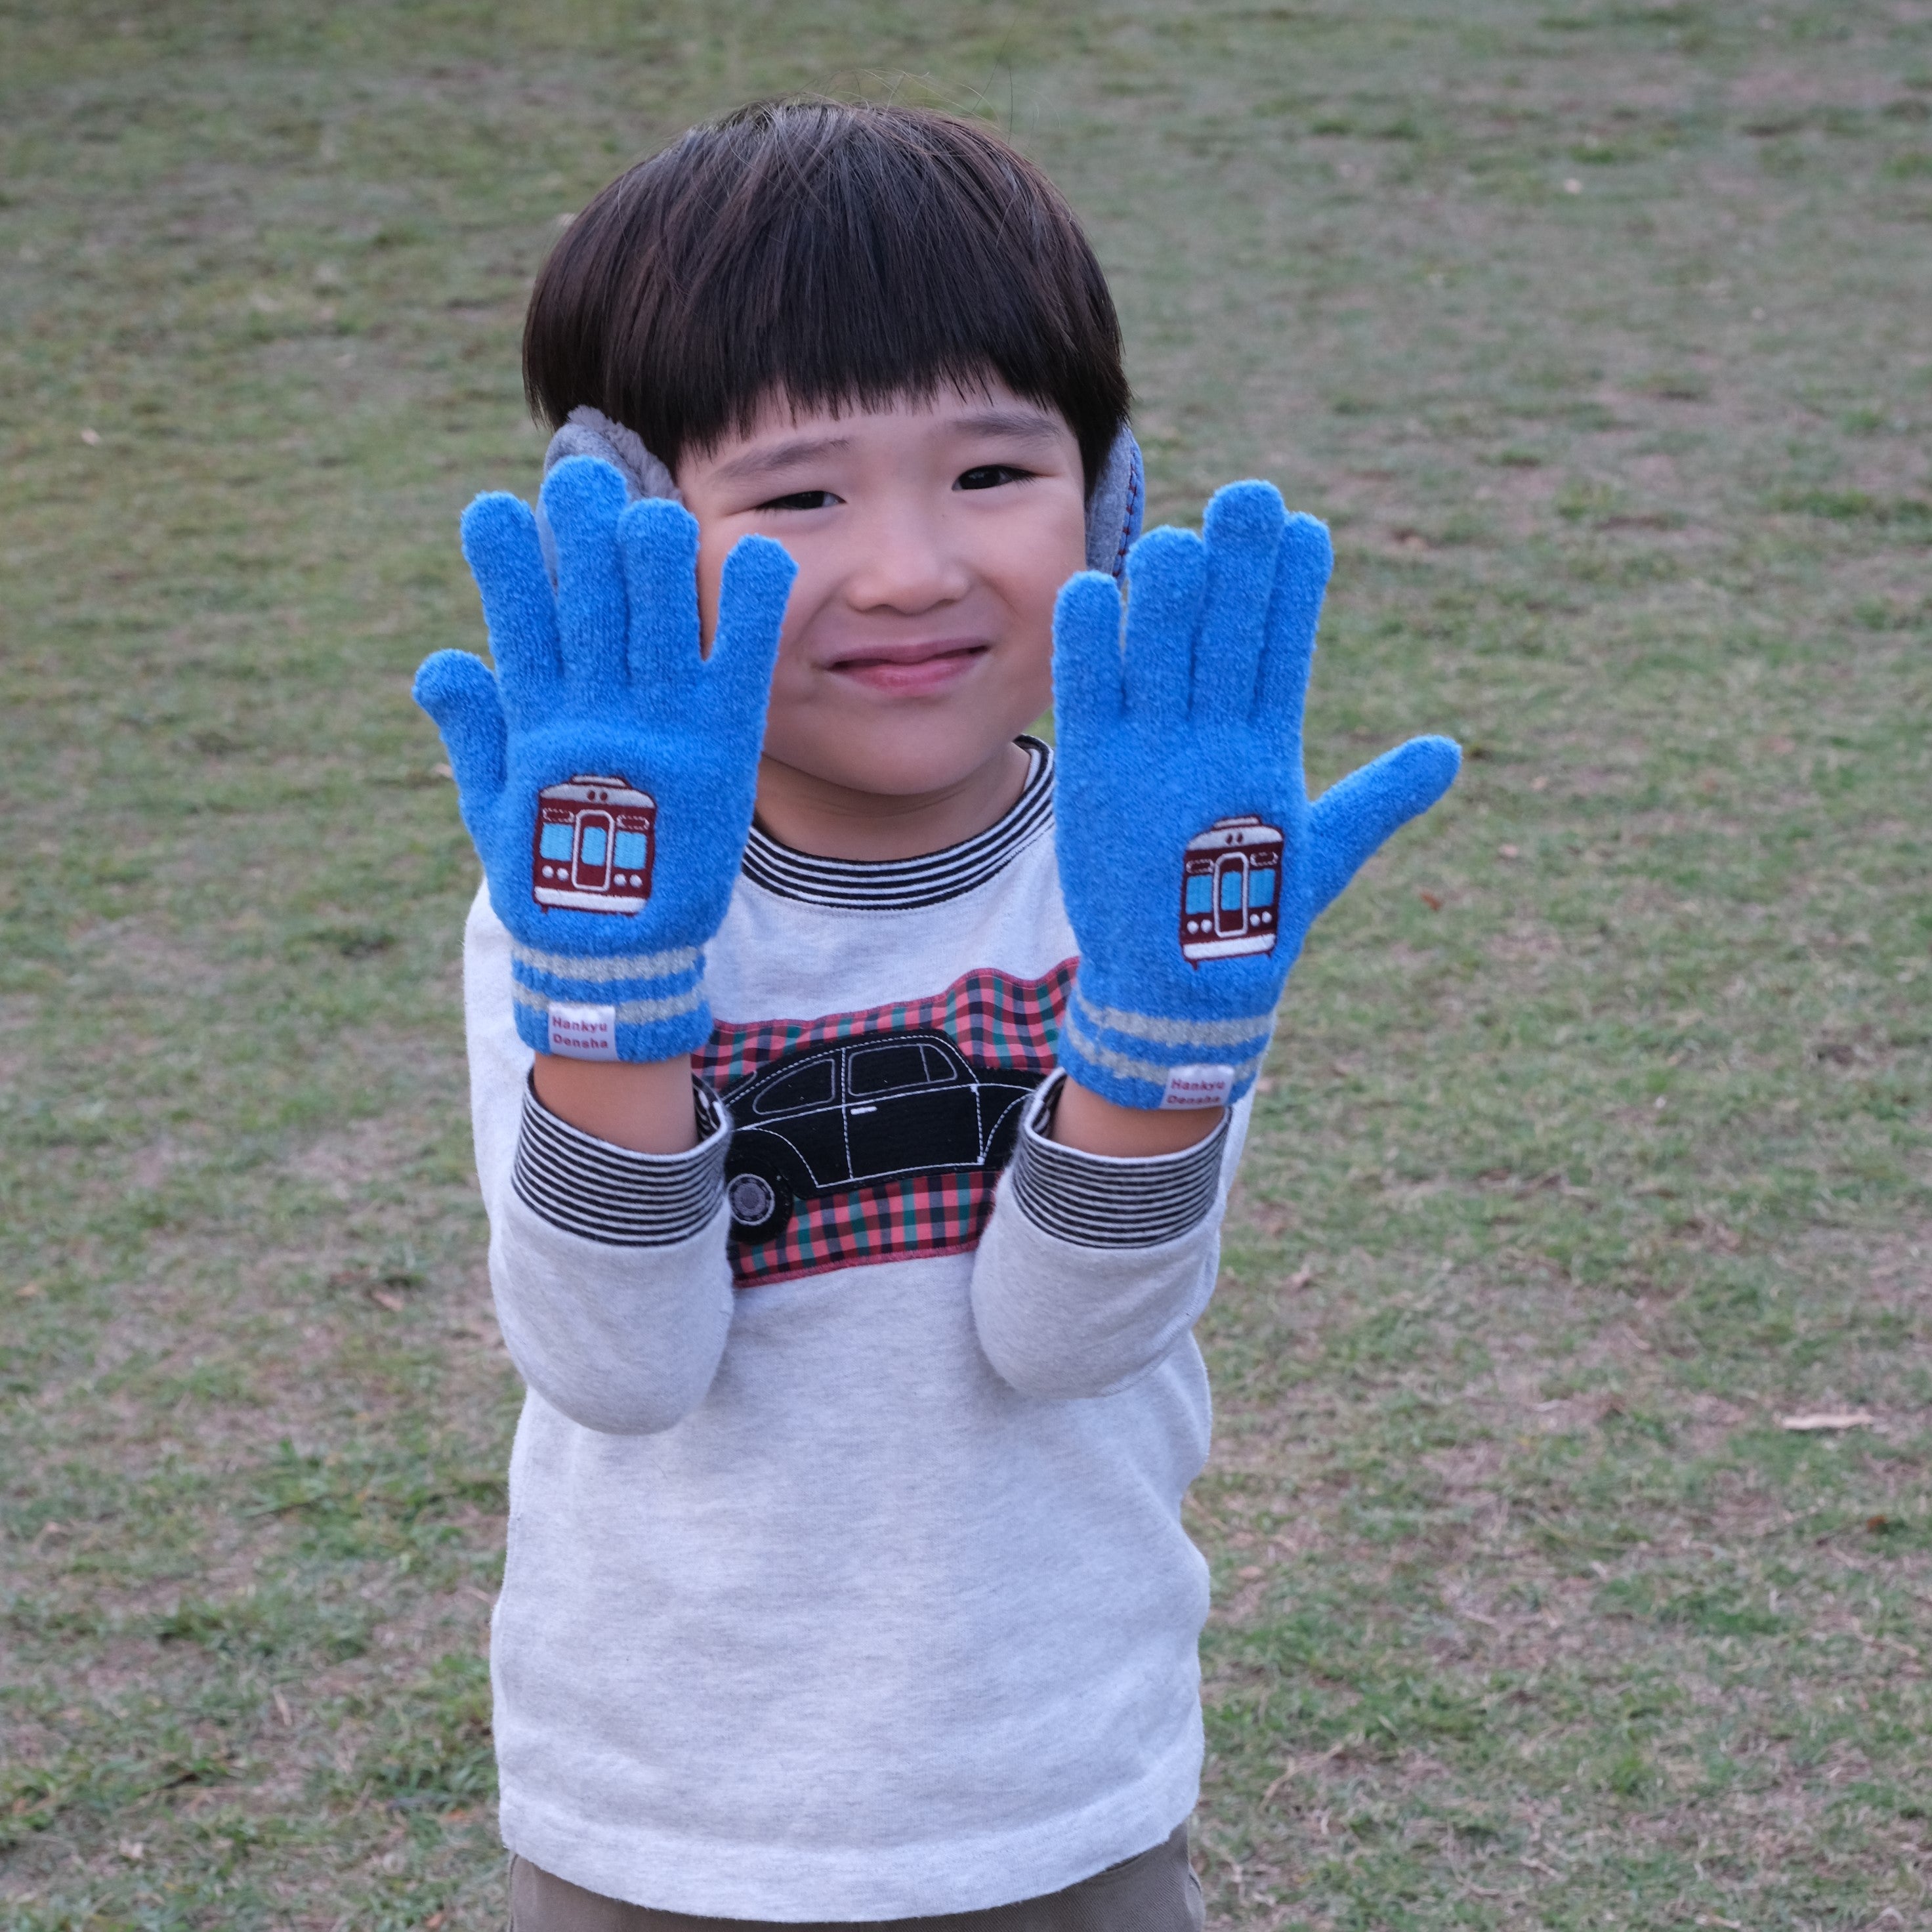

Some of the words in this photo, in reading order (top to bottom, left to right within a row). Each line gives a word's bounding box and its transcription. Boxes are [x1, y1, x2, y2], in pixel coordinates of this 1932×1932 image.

[553, 1016, 607, 1033] Hankyu
[553, 1033, 608, 1049] Densha
[1171, 1078, 1225, 1091] Hankyu
